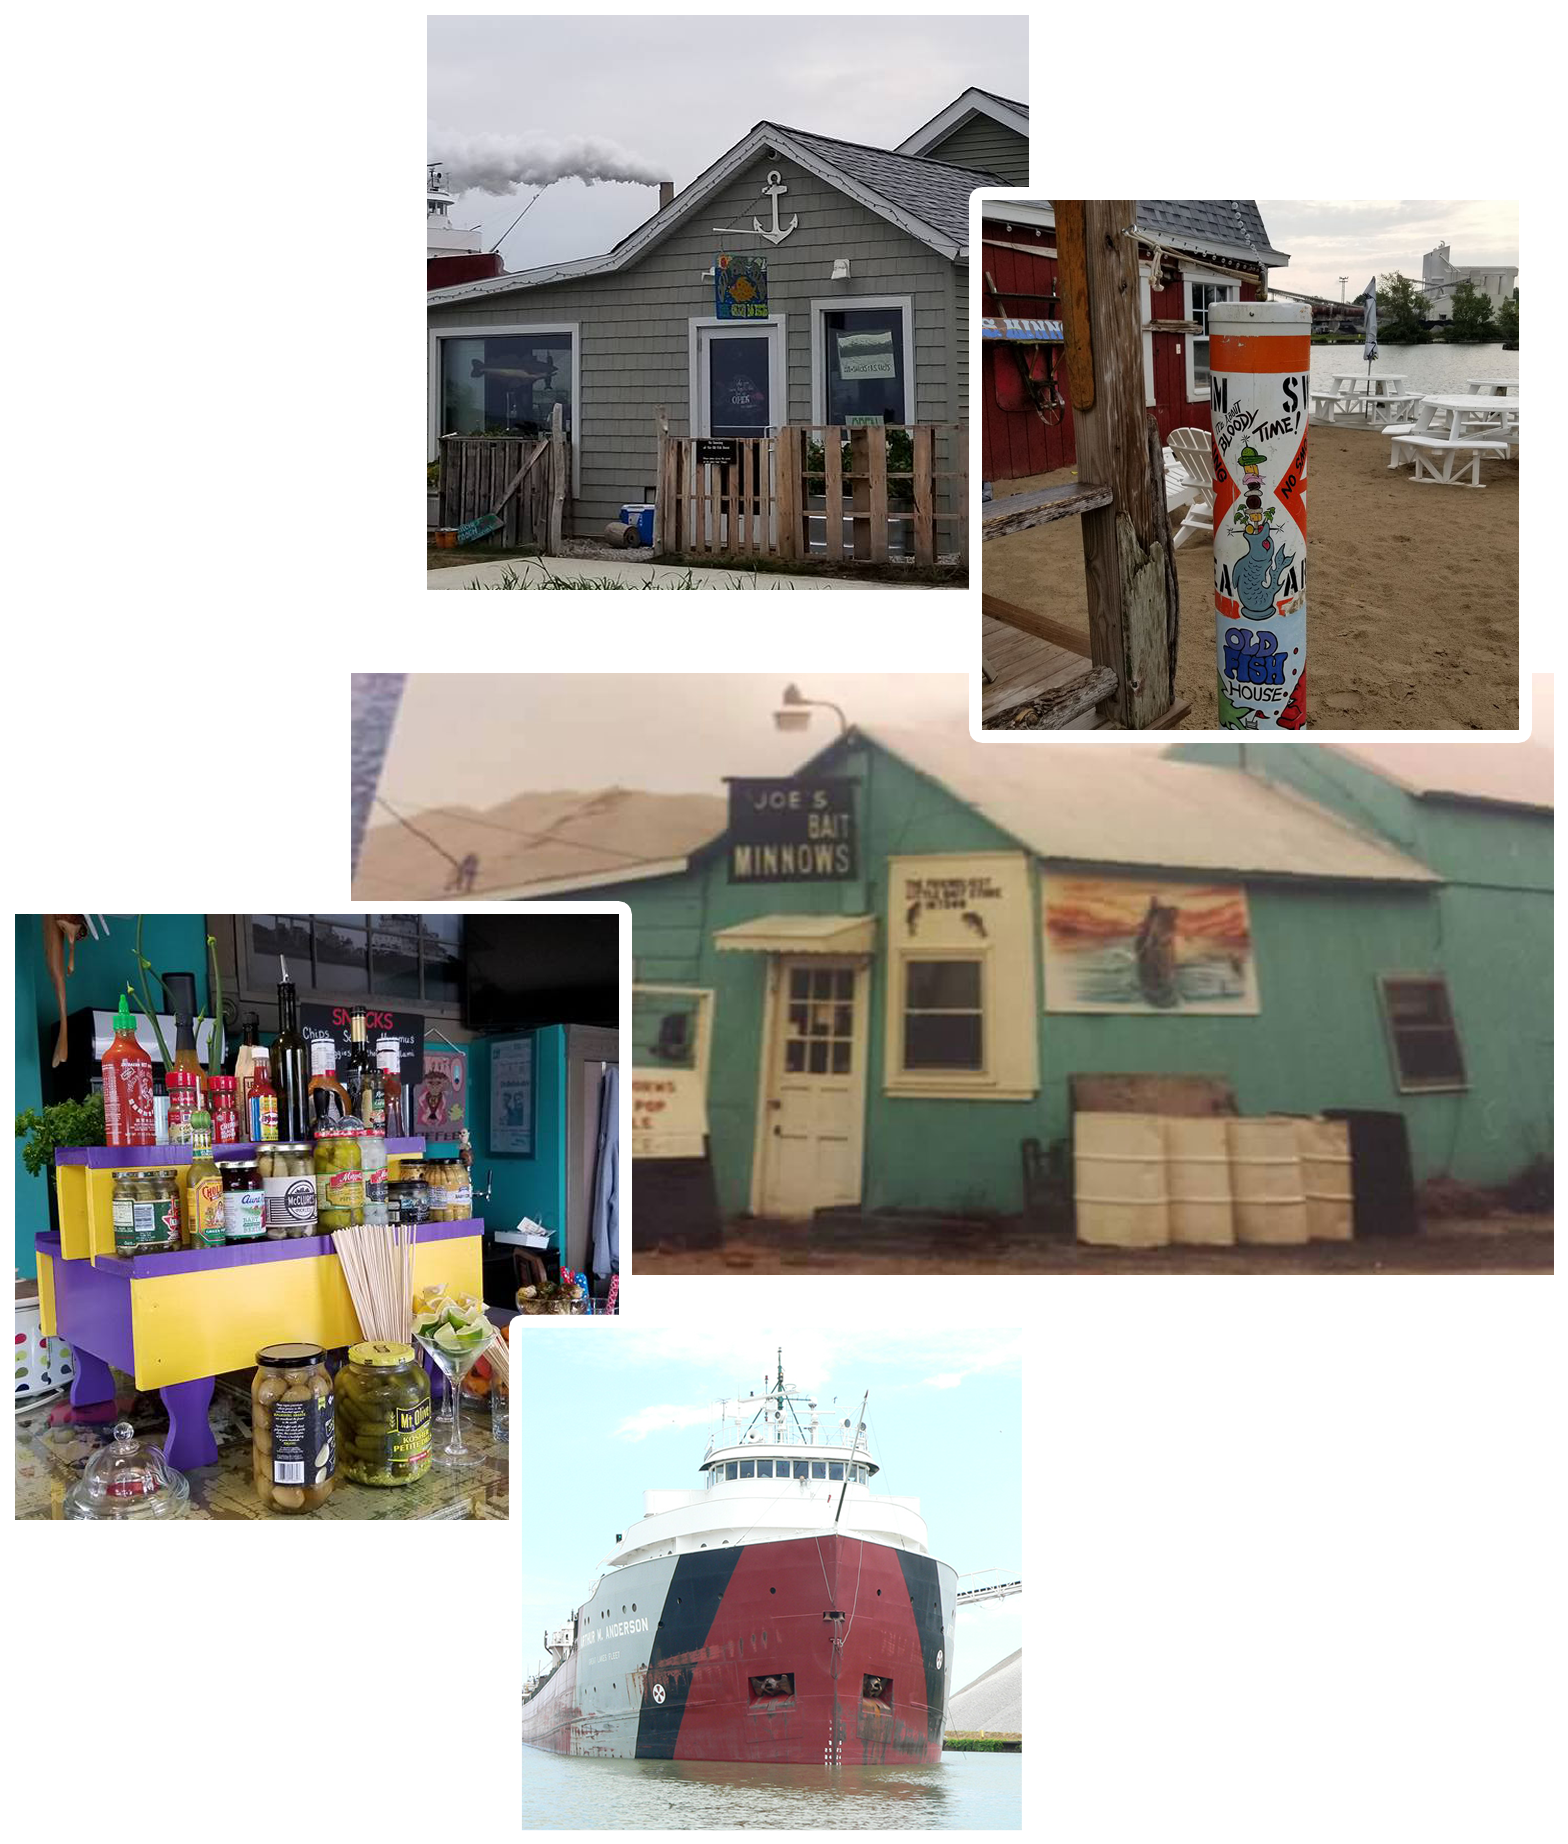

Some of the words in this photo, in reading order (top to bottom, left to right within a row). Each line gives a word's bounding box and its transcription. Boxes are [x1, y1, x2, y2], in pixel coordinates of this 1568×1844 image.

[1225, 400, 1242, 427] ABOUT
[1252, 410, 1302, 442] TIME!
[1218, 408, 1260, 457] BLOODY
[1281, 474, 1298, 500] NO
[1224, 627, 1279, 658] OLD
[1222, 644, 1289, 686] FISH
[1227, 680, 1283, 702] HOUSE
[807, 813, 850, 840] BAIT
[734, 843, 850, 877] MINNOWS
[332, 1008, 394, 1030] SNCKS
[302, 1026, 331, 1041] Chips
[605, 1617, 649, 1640] ANDERSON
